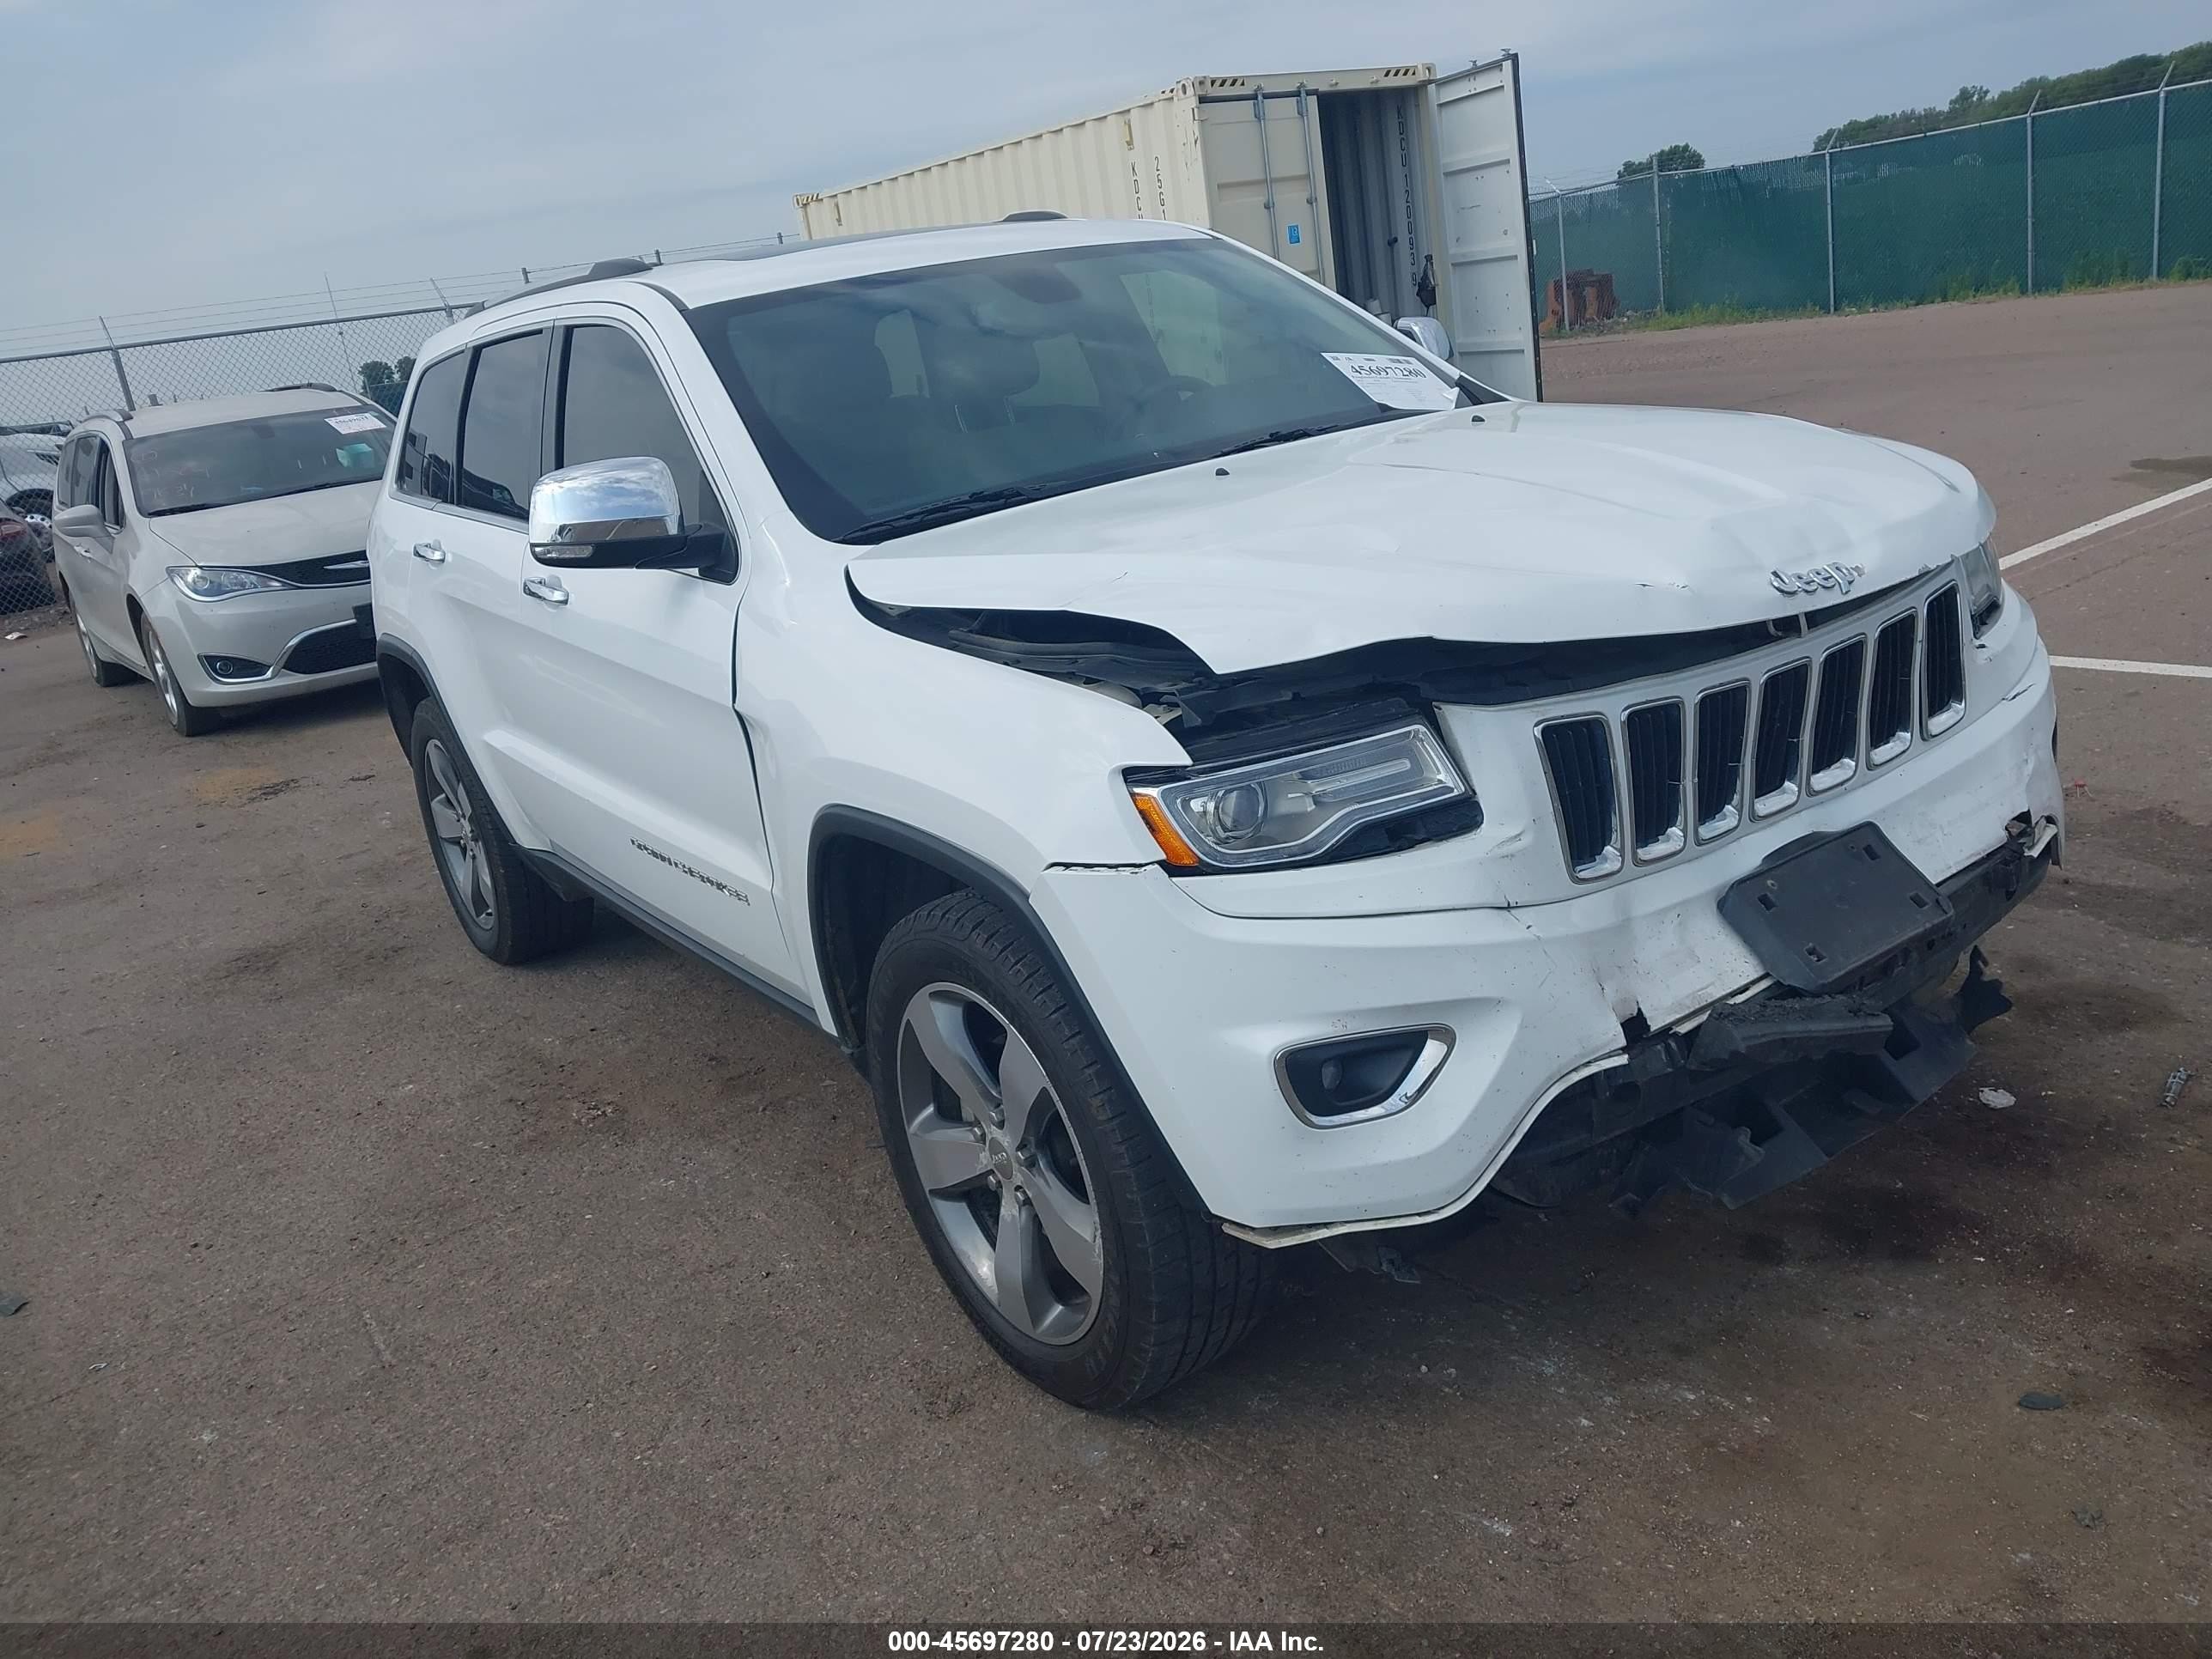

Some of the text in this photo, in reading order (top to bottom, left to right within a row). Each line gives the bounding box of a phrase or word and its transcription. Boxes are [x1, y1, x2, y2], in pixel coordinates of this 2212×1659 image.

[1154, 155, 1167, 221] 25G1
[1396, 104, 1407, 167] KDCU
[1404, 173, 1416, 266] 120093
[1350, 363, 1428, 380] 45697280
[1770, 562, 1856, 596] Jeep
